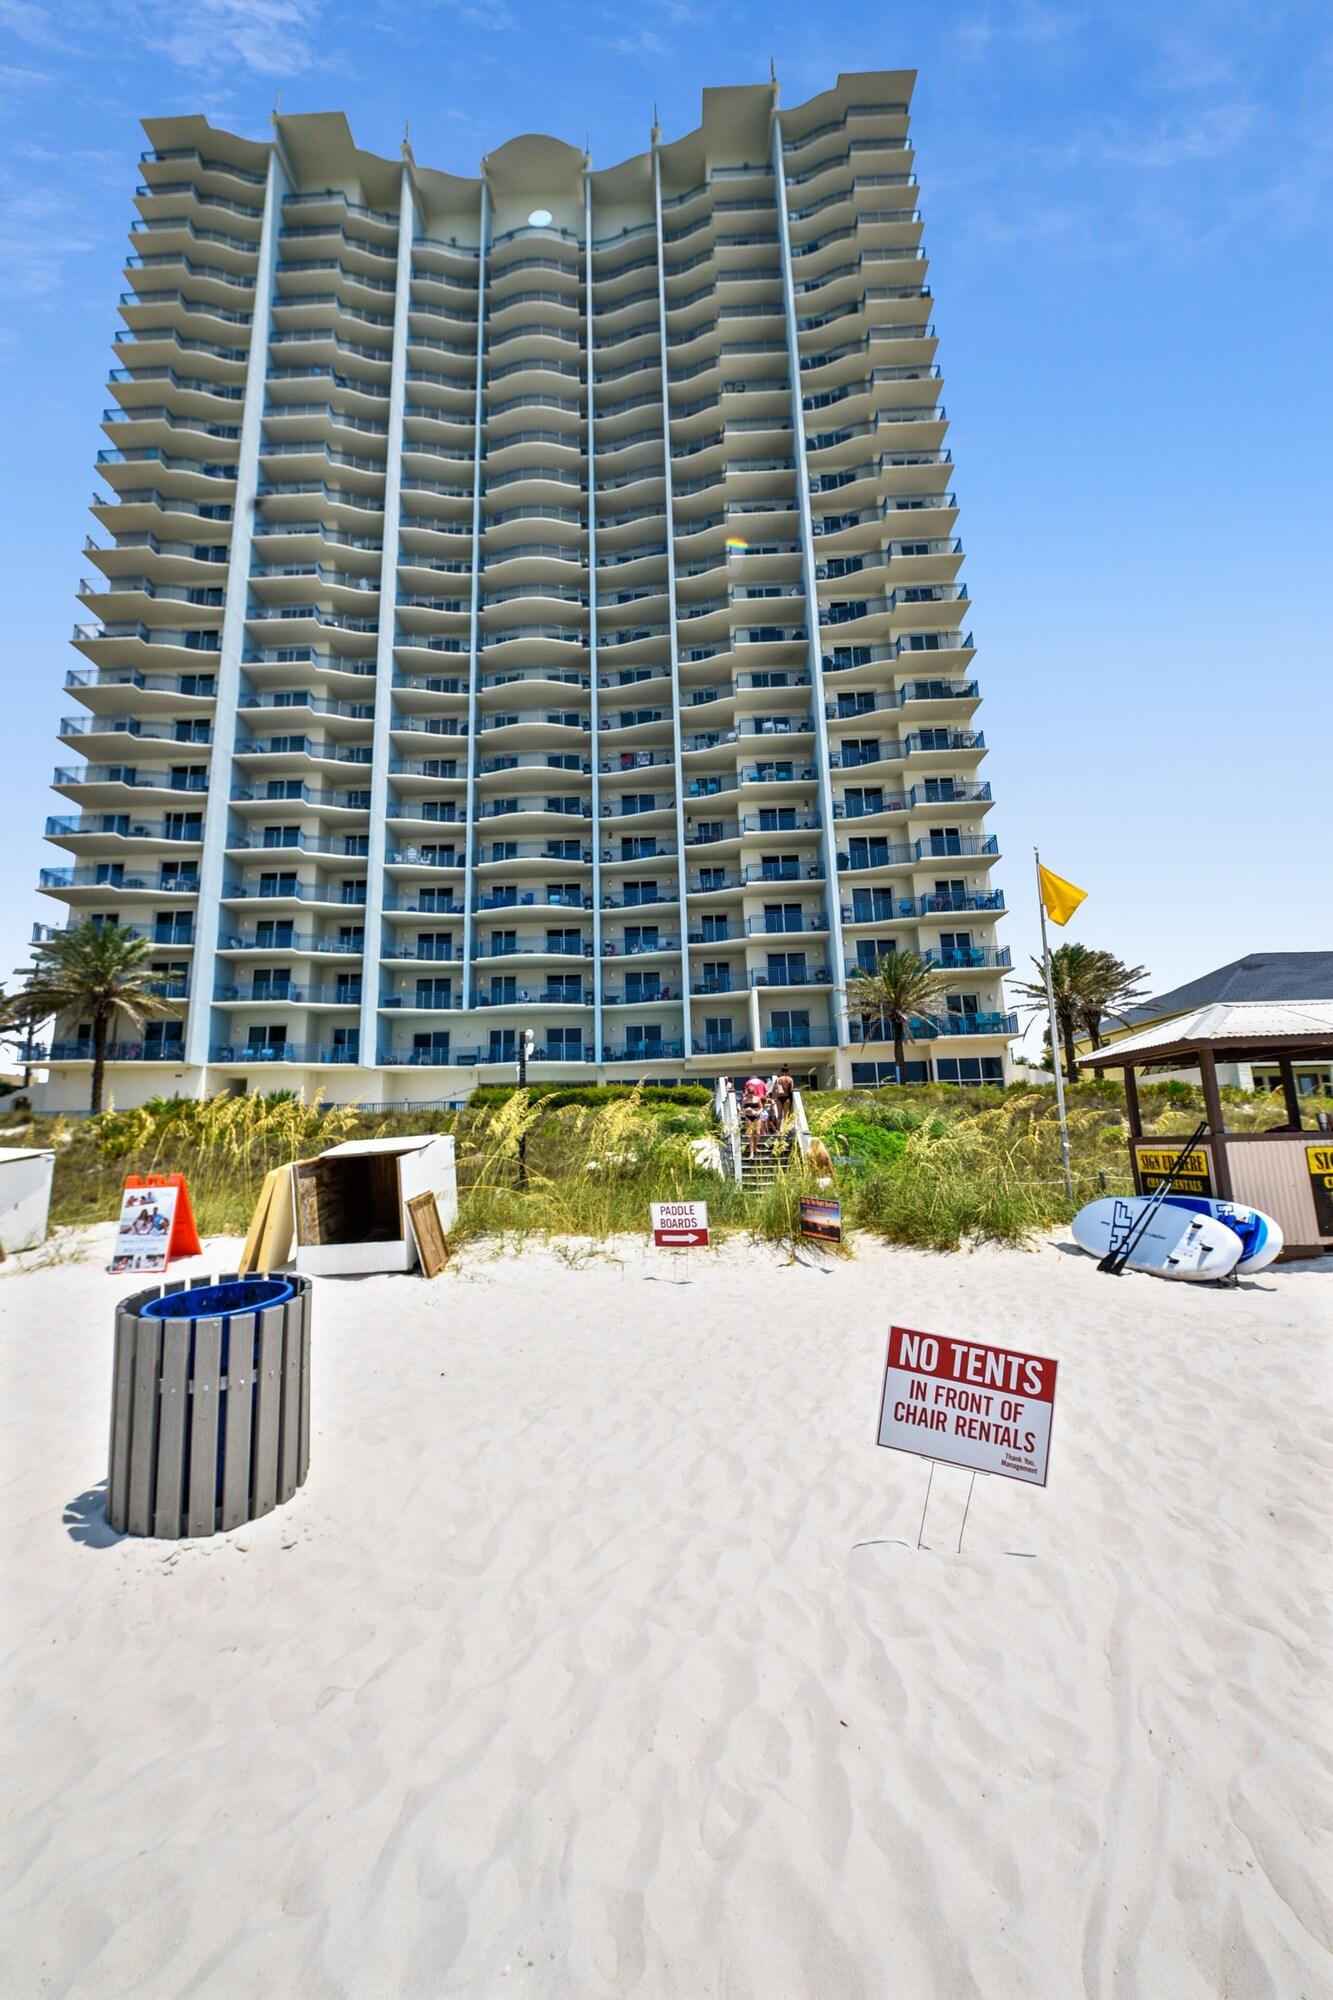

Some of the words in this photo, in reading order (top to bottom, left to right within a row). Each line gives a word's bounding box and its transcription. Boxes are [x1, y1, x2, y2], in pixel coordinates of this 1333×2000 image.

[1141, 1154, 1161, 1170] SIGN
[660, 1204, 696, 1216] PADDLE
[660, 1217, 698, 1229] BOARDS
[899, 1333, 939, 1372] NO
[950, 1343, 1043, 1395] TENTS
[909, 1379, 928, 1401] IN
[934, 1385, 994, 1416] FRONT
[1000, 1400, 1025, 1423] OF
[893, 1401, 948, 1432] CHAIR
[954, 1415, 1036, 1453] RENTALS
[1005, 1452, 1022, 1462] Thank
[1001, 1459, 1038, 1475] Management
